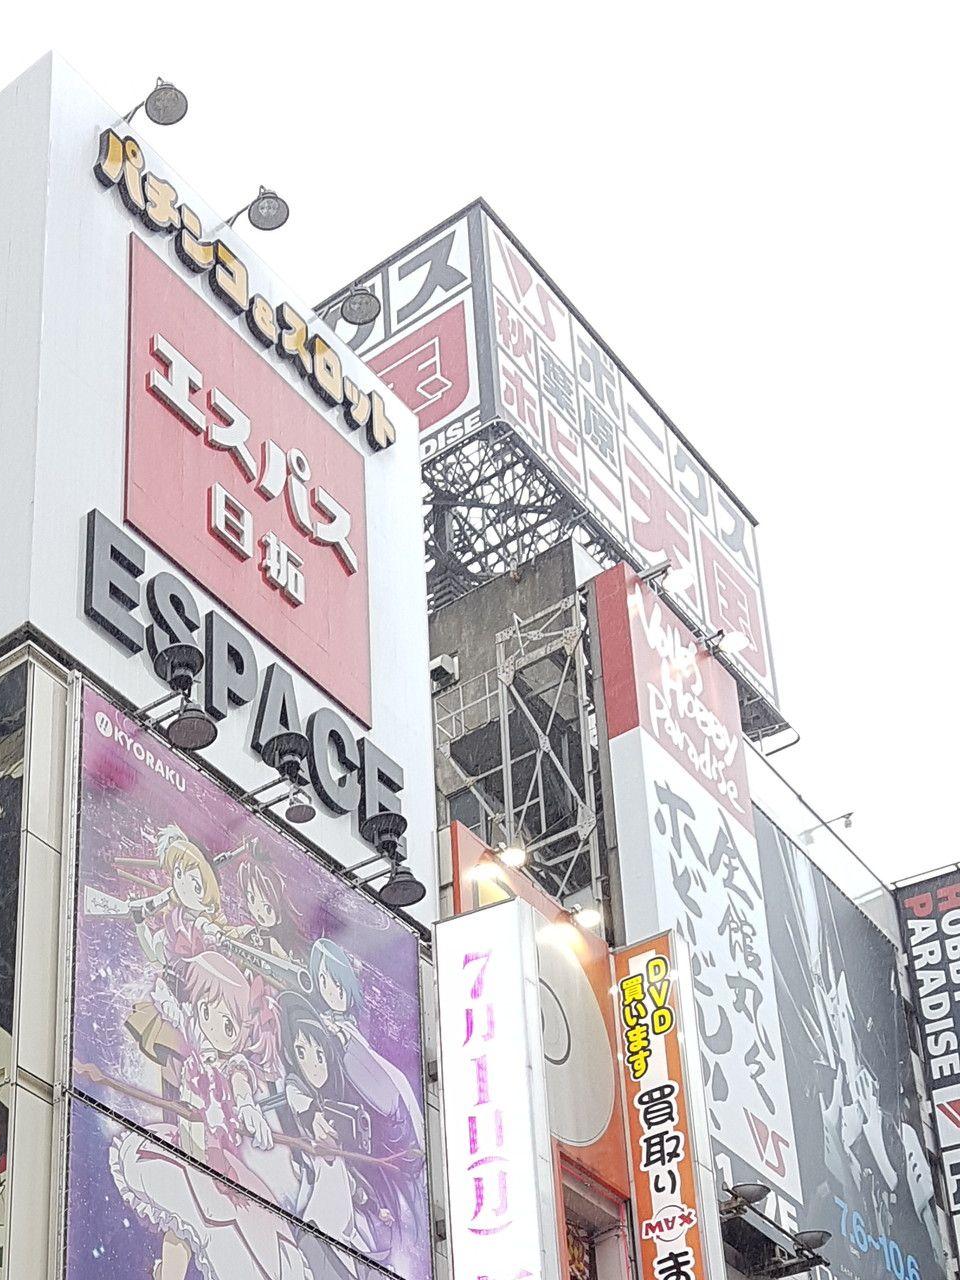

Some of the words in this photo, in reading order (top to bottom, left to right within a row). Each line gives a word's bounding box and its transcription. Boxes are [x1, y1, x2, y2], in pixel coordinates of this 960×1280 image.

[146, 333, 359, 577] エスパス
[497, 297, 618, 469] 秋葉原
[502, 362, 623, 511] ホビー
[577, 334, 756, 574] ボークス
[207, 481, 306, 609] 日拓
[84, 508, 406, 862] ESPACE
[112, 722, 187, 792] KYORAKU
[619, 973, 654, 1082] 買います
[647, 956, 675, 1036] DVD
[904, 892, 960, 1080] PARADISE
[637, 1084, 685, 1197] 買取り
